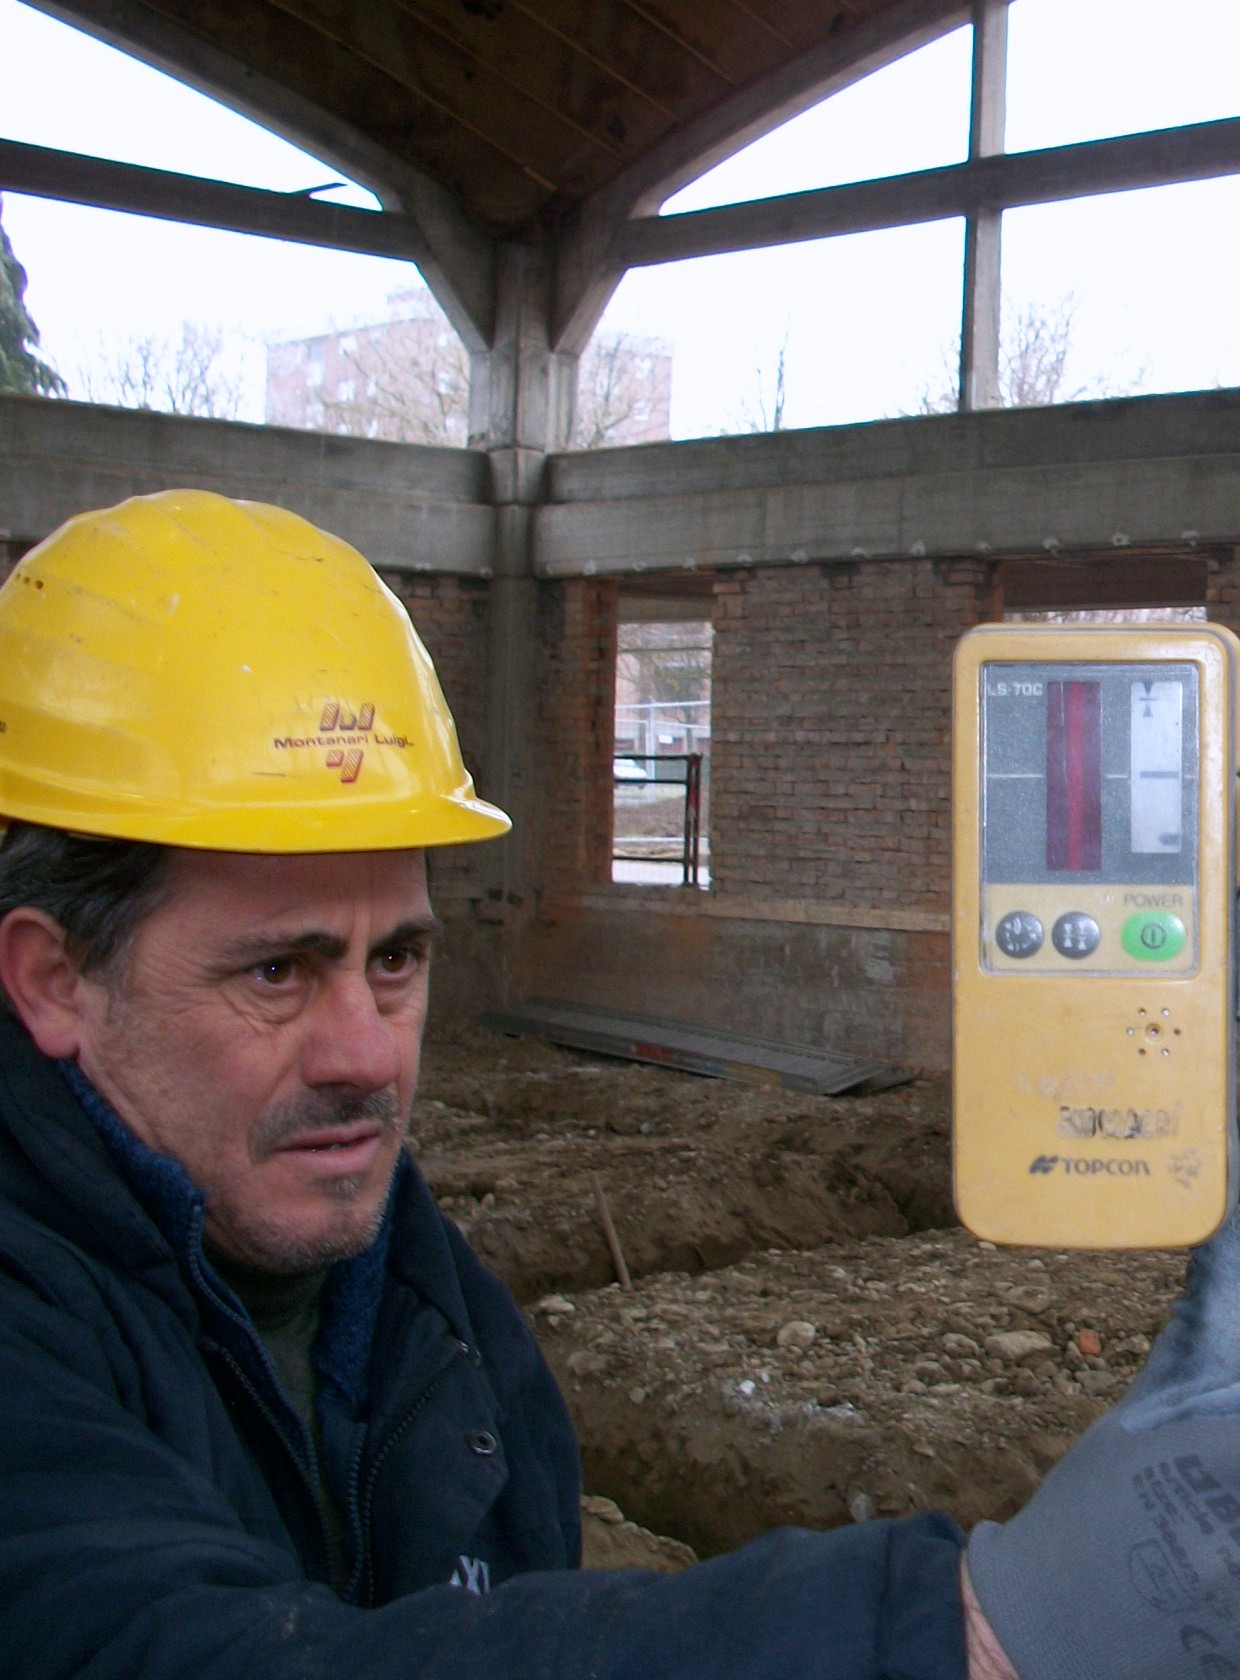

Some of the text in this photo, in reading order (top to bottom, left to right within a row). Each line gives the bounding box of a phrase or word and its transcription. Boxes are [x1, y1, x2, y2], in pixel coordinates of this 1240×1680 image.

[273, 735, 368, 749] Montanari
[1123, 893, 1183, 907] POWER
[1062, 1157, 1151, 1176] TOPCON
